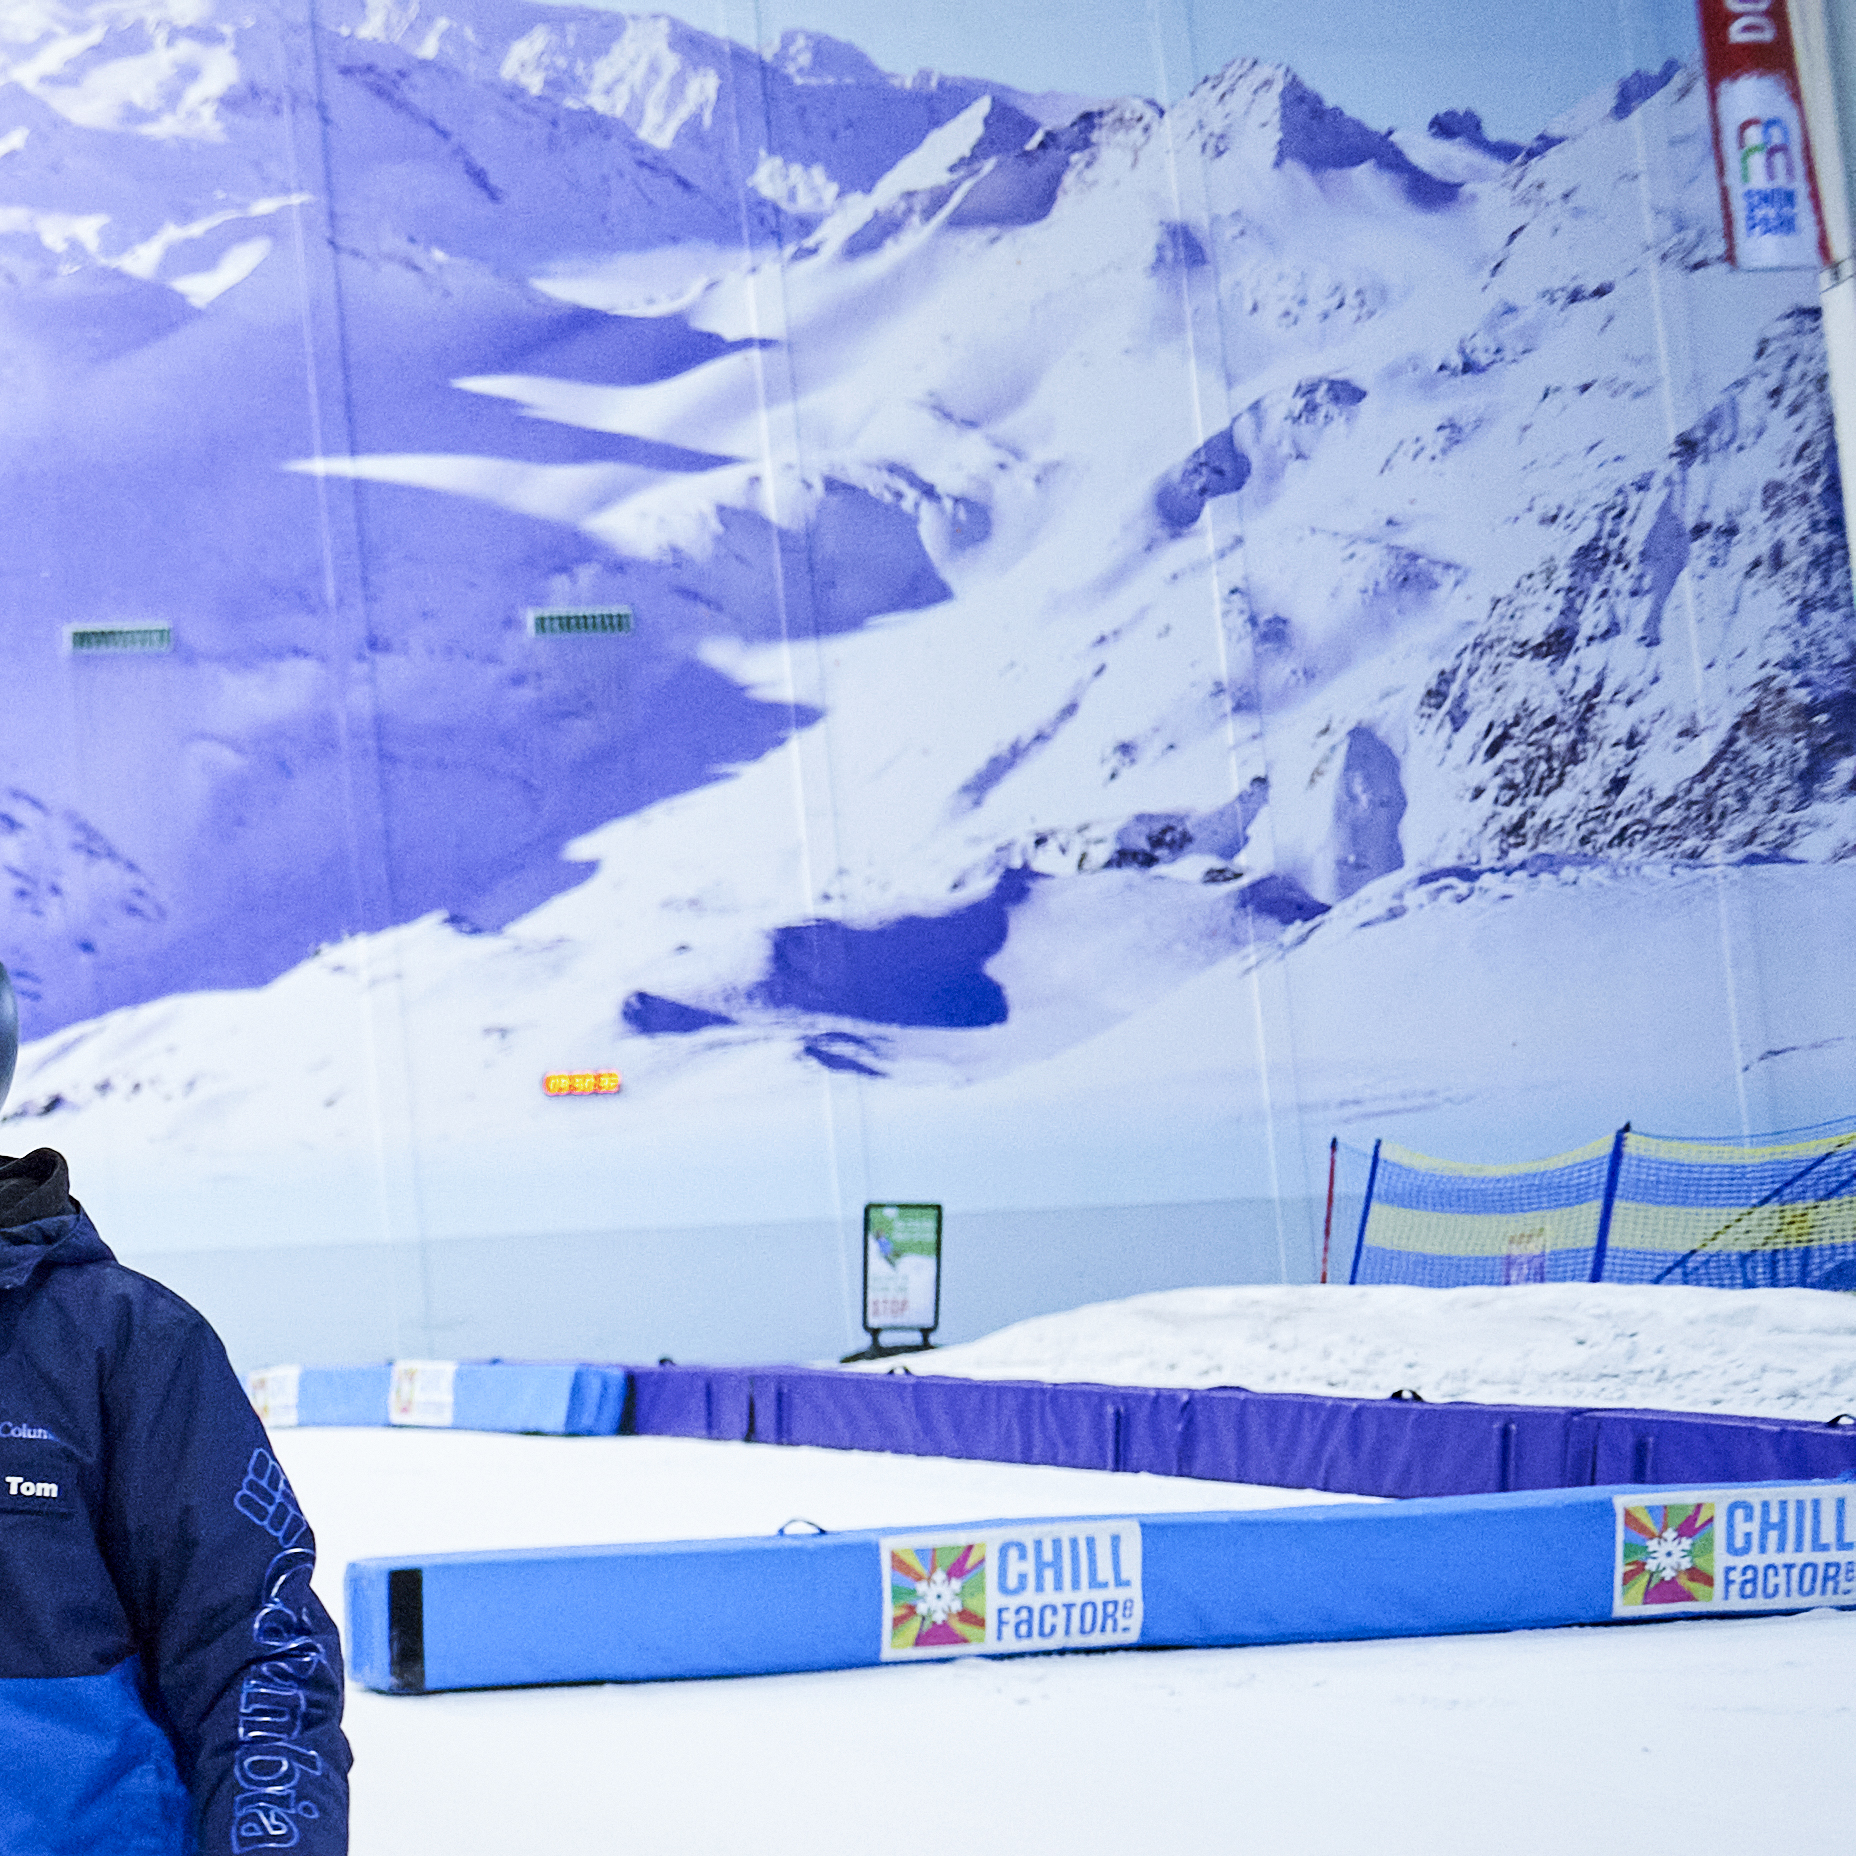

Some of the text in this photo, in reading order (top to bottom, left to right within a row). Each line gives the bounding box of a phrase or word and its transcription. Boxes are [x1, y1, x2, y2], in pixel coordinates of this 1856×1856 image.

[5, 1476, 59, 1498] Tom
[1724, 1497, 1856, 1558] CHILL
[996, 1533, 1132, 1597] CHILL
